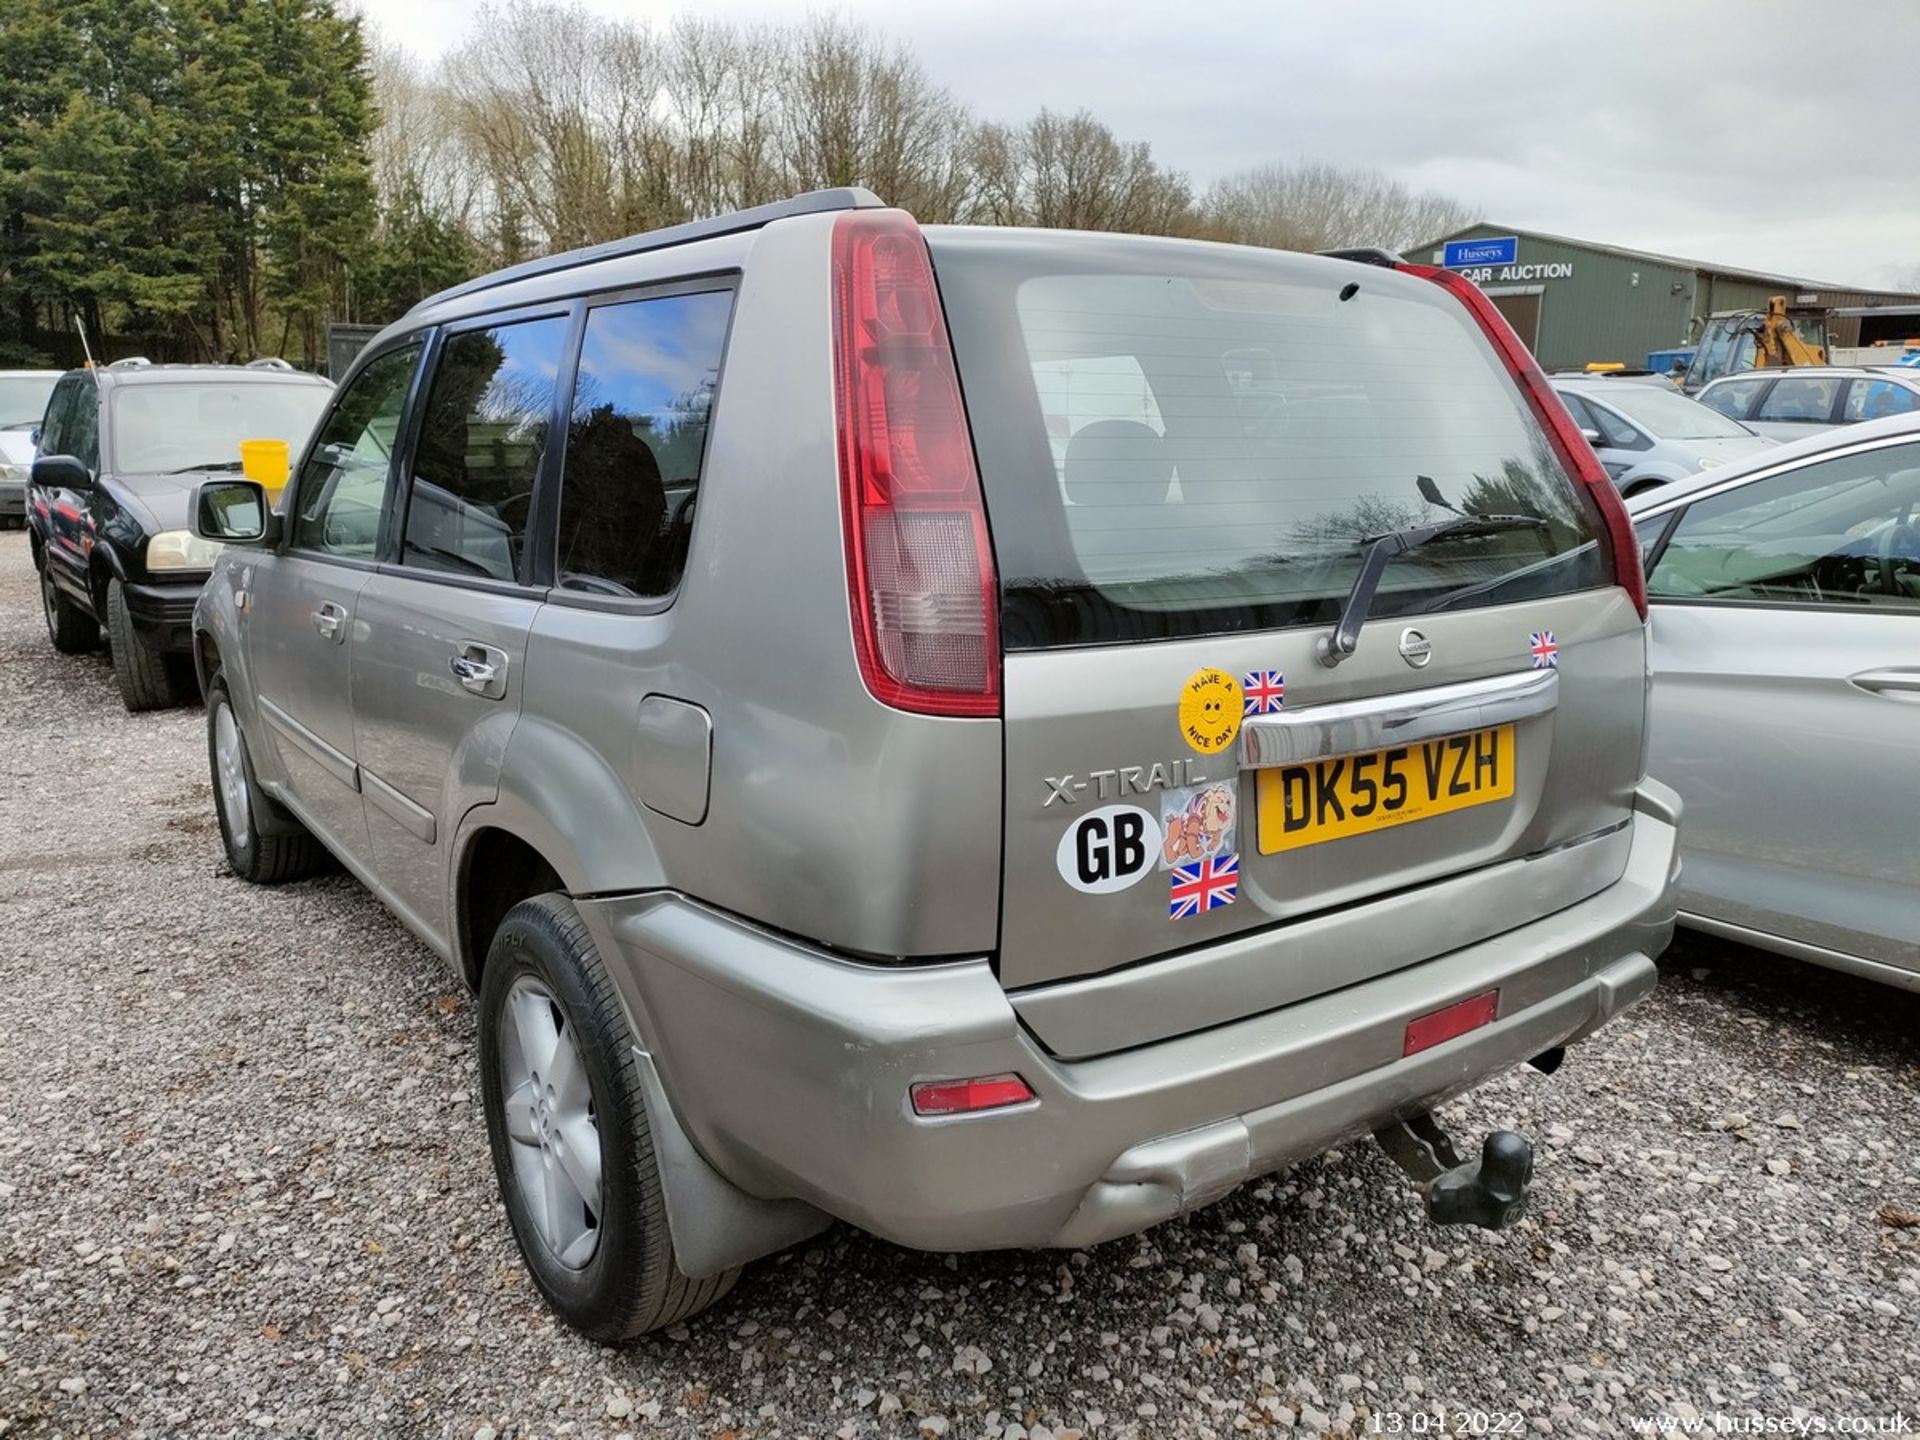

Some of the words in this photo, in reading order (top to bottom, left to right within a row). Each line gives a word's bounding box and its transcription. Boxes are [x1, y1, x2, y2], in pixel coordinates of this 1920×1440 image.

[1457, 248, 1503, 260] Husseys
[1461, 268, 1492, 281] CAR
[1500, 263, 1572, 280] AUCTION
[1192, 674, 1220, 692] HAVE
[1225, 682, 1233, 692] A
[1188, 725, 1210, 748] NICE
[1215, 725, 1233, 746] DAY
[1042, 758, 1207, 808] X-TRAIL
[1281, 749, 1408, 833] DK55
[1422, 730, 1499, 801] VZH
[1076, 812, 1145, 884] GB
